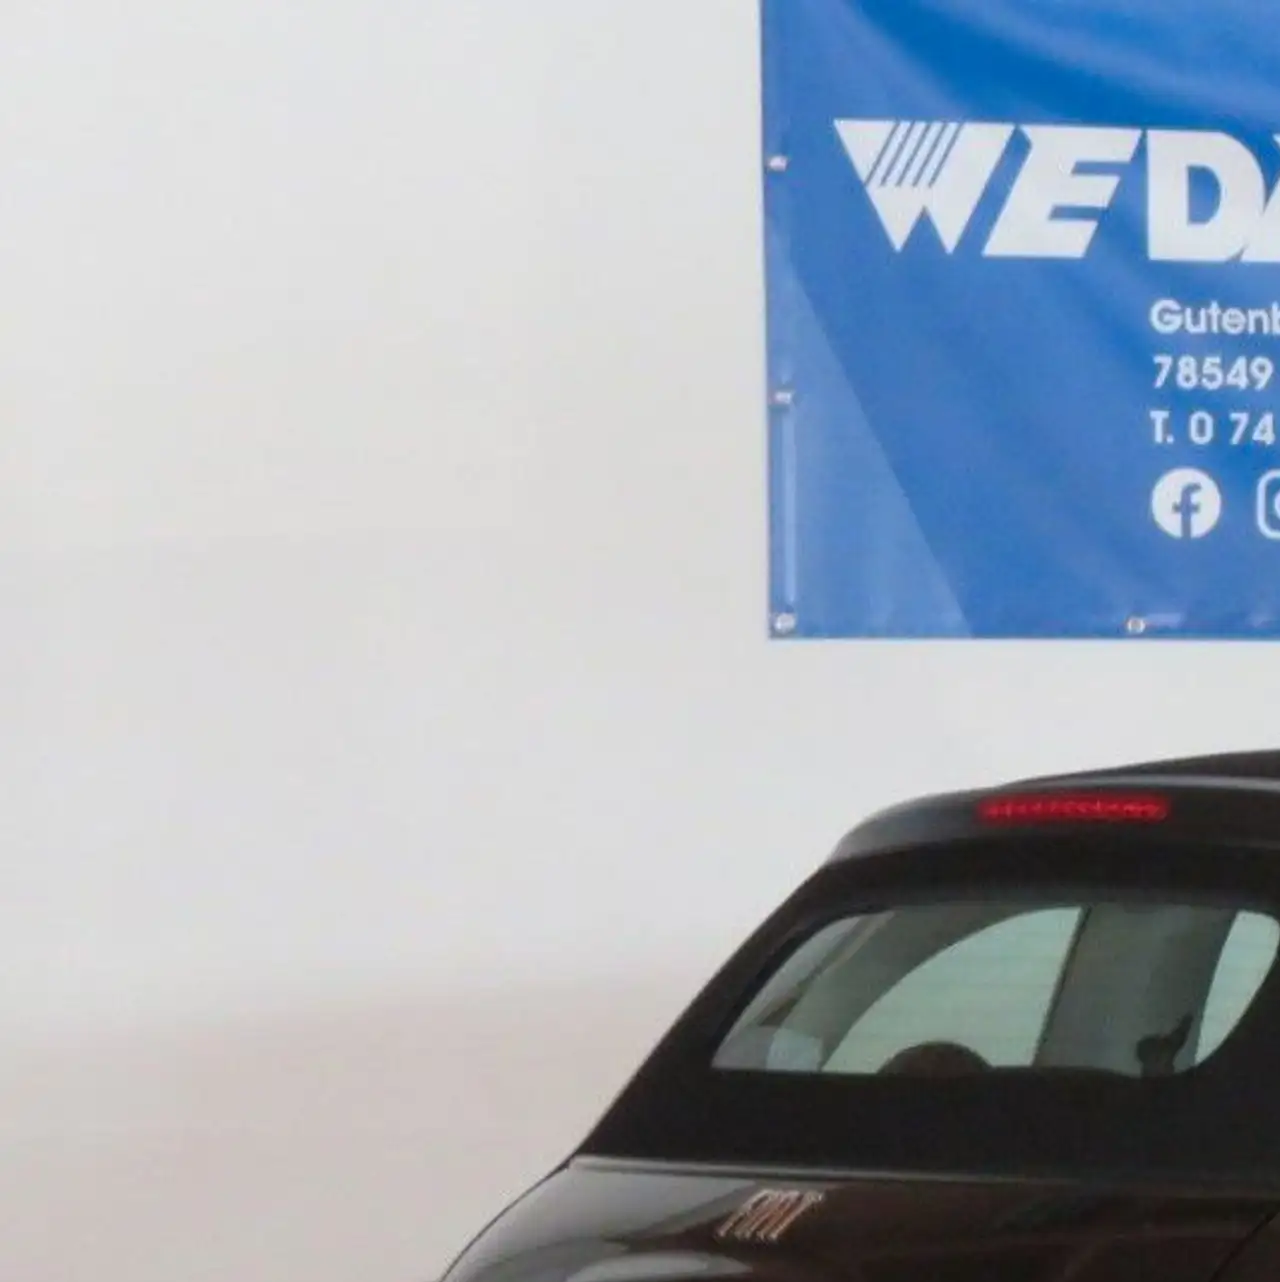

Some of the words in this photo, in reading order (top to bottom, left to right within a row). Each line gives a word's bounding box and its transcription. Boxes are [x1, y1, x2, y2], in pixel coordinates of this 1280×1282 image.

[1154, 355, 1274, 391] 78549
[1150, 410, 1174, 444] T.
[1190, 411, 1214, 445] 0
[1230, 413, 1275, 446] 74
